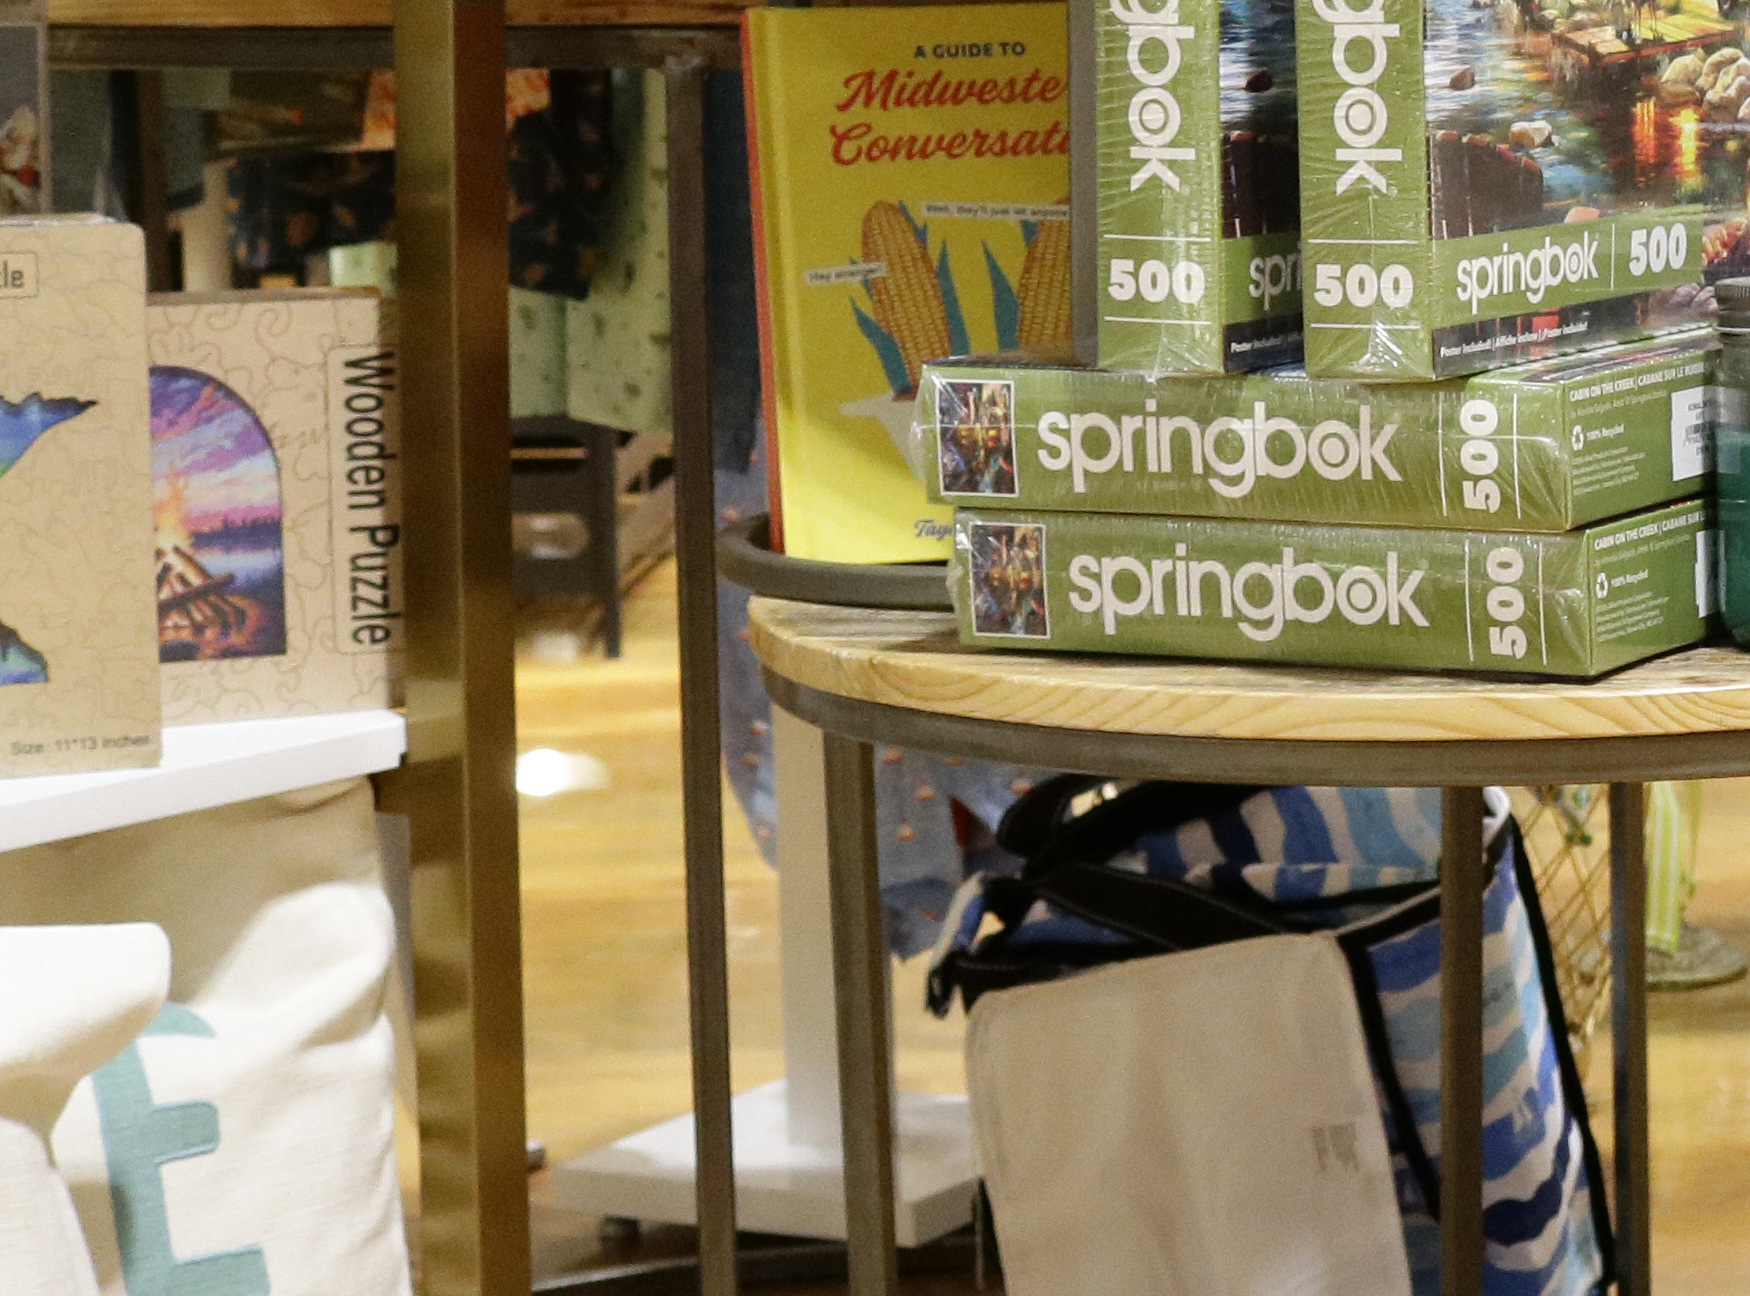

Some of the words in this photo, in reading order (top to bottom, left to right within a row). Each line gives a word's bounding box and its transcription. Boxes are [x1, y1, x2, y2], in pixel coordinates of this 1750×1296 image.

[836, 67, 1068, 113] Midweste
[914, 45, 926, 59] A
[932, 43, 994, 59] GUIDE
[999, 42, 1026, 56] TO
[1107, 258, 1205, 303] 500
[1312, 263, 1415, 308] 500
[1456, 231, 1599, 315] springbok
[1628, 222, 1688, 276] 500
[343, 352, 396, 509] Wooden
[1037, 398, 1403, 499] springbok
[1460, 398, 1502, 513] 500
[348, 524, 401, 645] Puzzle
[1069, 543, 1431, 643] springbok
[1487, 546, 1526, 661] 500
